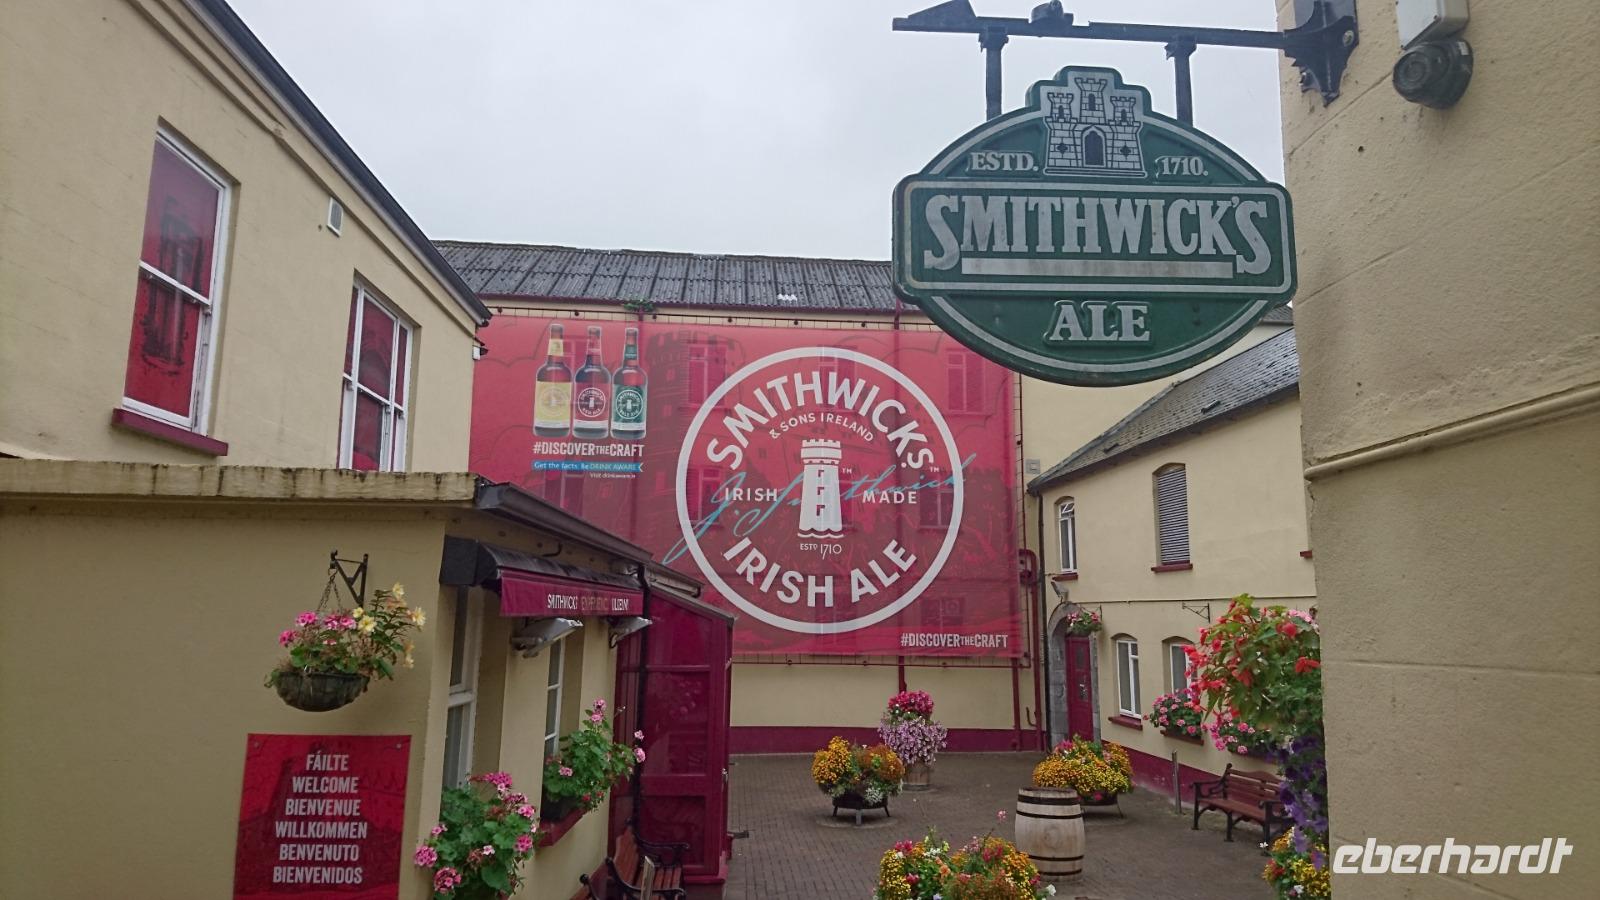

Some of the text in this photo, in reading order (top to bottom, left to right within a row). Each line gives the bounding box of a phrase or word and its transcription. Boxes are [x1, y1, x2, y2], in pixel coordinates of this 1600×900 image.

[970, 152, 1209, 177] ESTD. 1710.
[924, 193, 1272, 275] SMITHWICK'S
[1050, 303, 1151, 343] ALE
[769, 412, 874, 442] & SONS IRELAND
[534, 461, 547, 469] Get
[548, 461, 560, 469] the
[725, 487, 918, 504] IRISH MADE
[820, 543, 842, 560] 1710
[723, 536, 918, 608] IRISH ALE
[305, 750, 349, 771] FÁILTE
[292, 776, 359, 794] WELCOME
[285, 799, 361, 816] BIENVENUE
[275, 821, 367, 839] WILLKOMMEN
[279, 844, 359, 861] BENVENUTO
[273, 866, 363, 884] BIENVENIDOS
